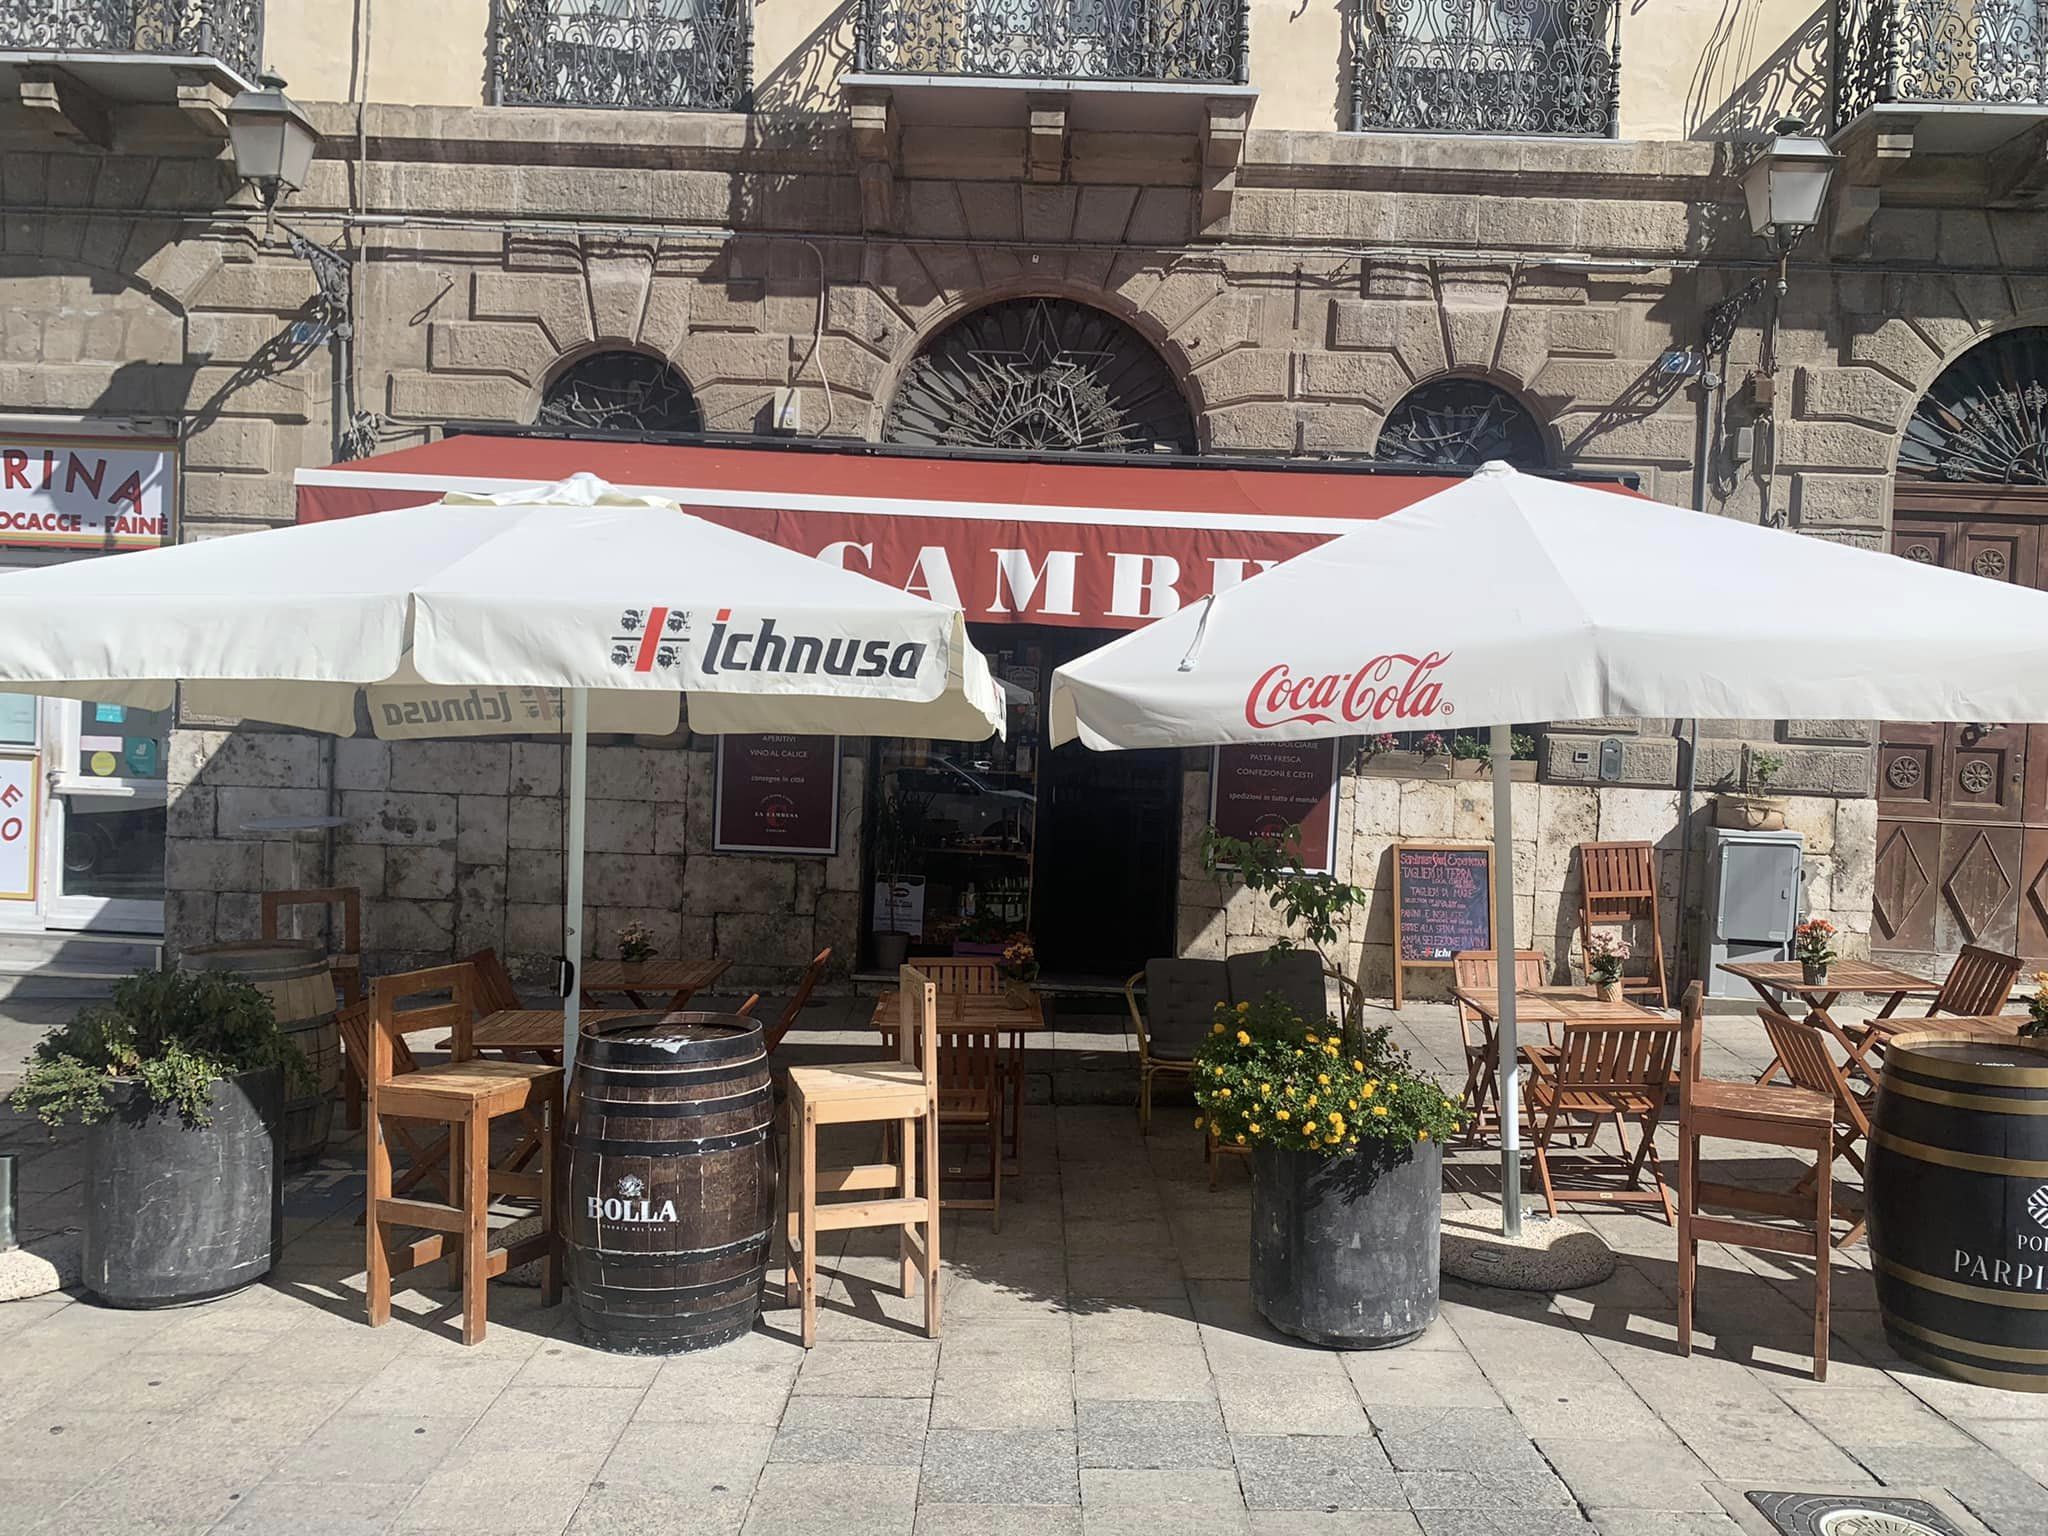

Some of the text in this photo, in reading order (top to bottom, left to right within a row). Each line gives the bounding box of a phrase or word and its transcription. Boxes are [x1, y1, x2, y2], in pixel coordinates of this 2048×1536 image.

[3, 449, 142, 515] RINA
[105, 512, 168, 535] FAINÈ
[750, 749, 769, 757] VINO
[781, 750, 807, 758] CALICE
[1249, 753, 1301, 763] PASTA FRESCA
[1236, 767, 1285, 777] CONFEZIONI
[1292, 771, 1313, 779] CESTI
[1445, 866, 1473, 880] TERRA
[587, 1196, 677, 1222] BOLLA
